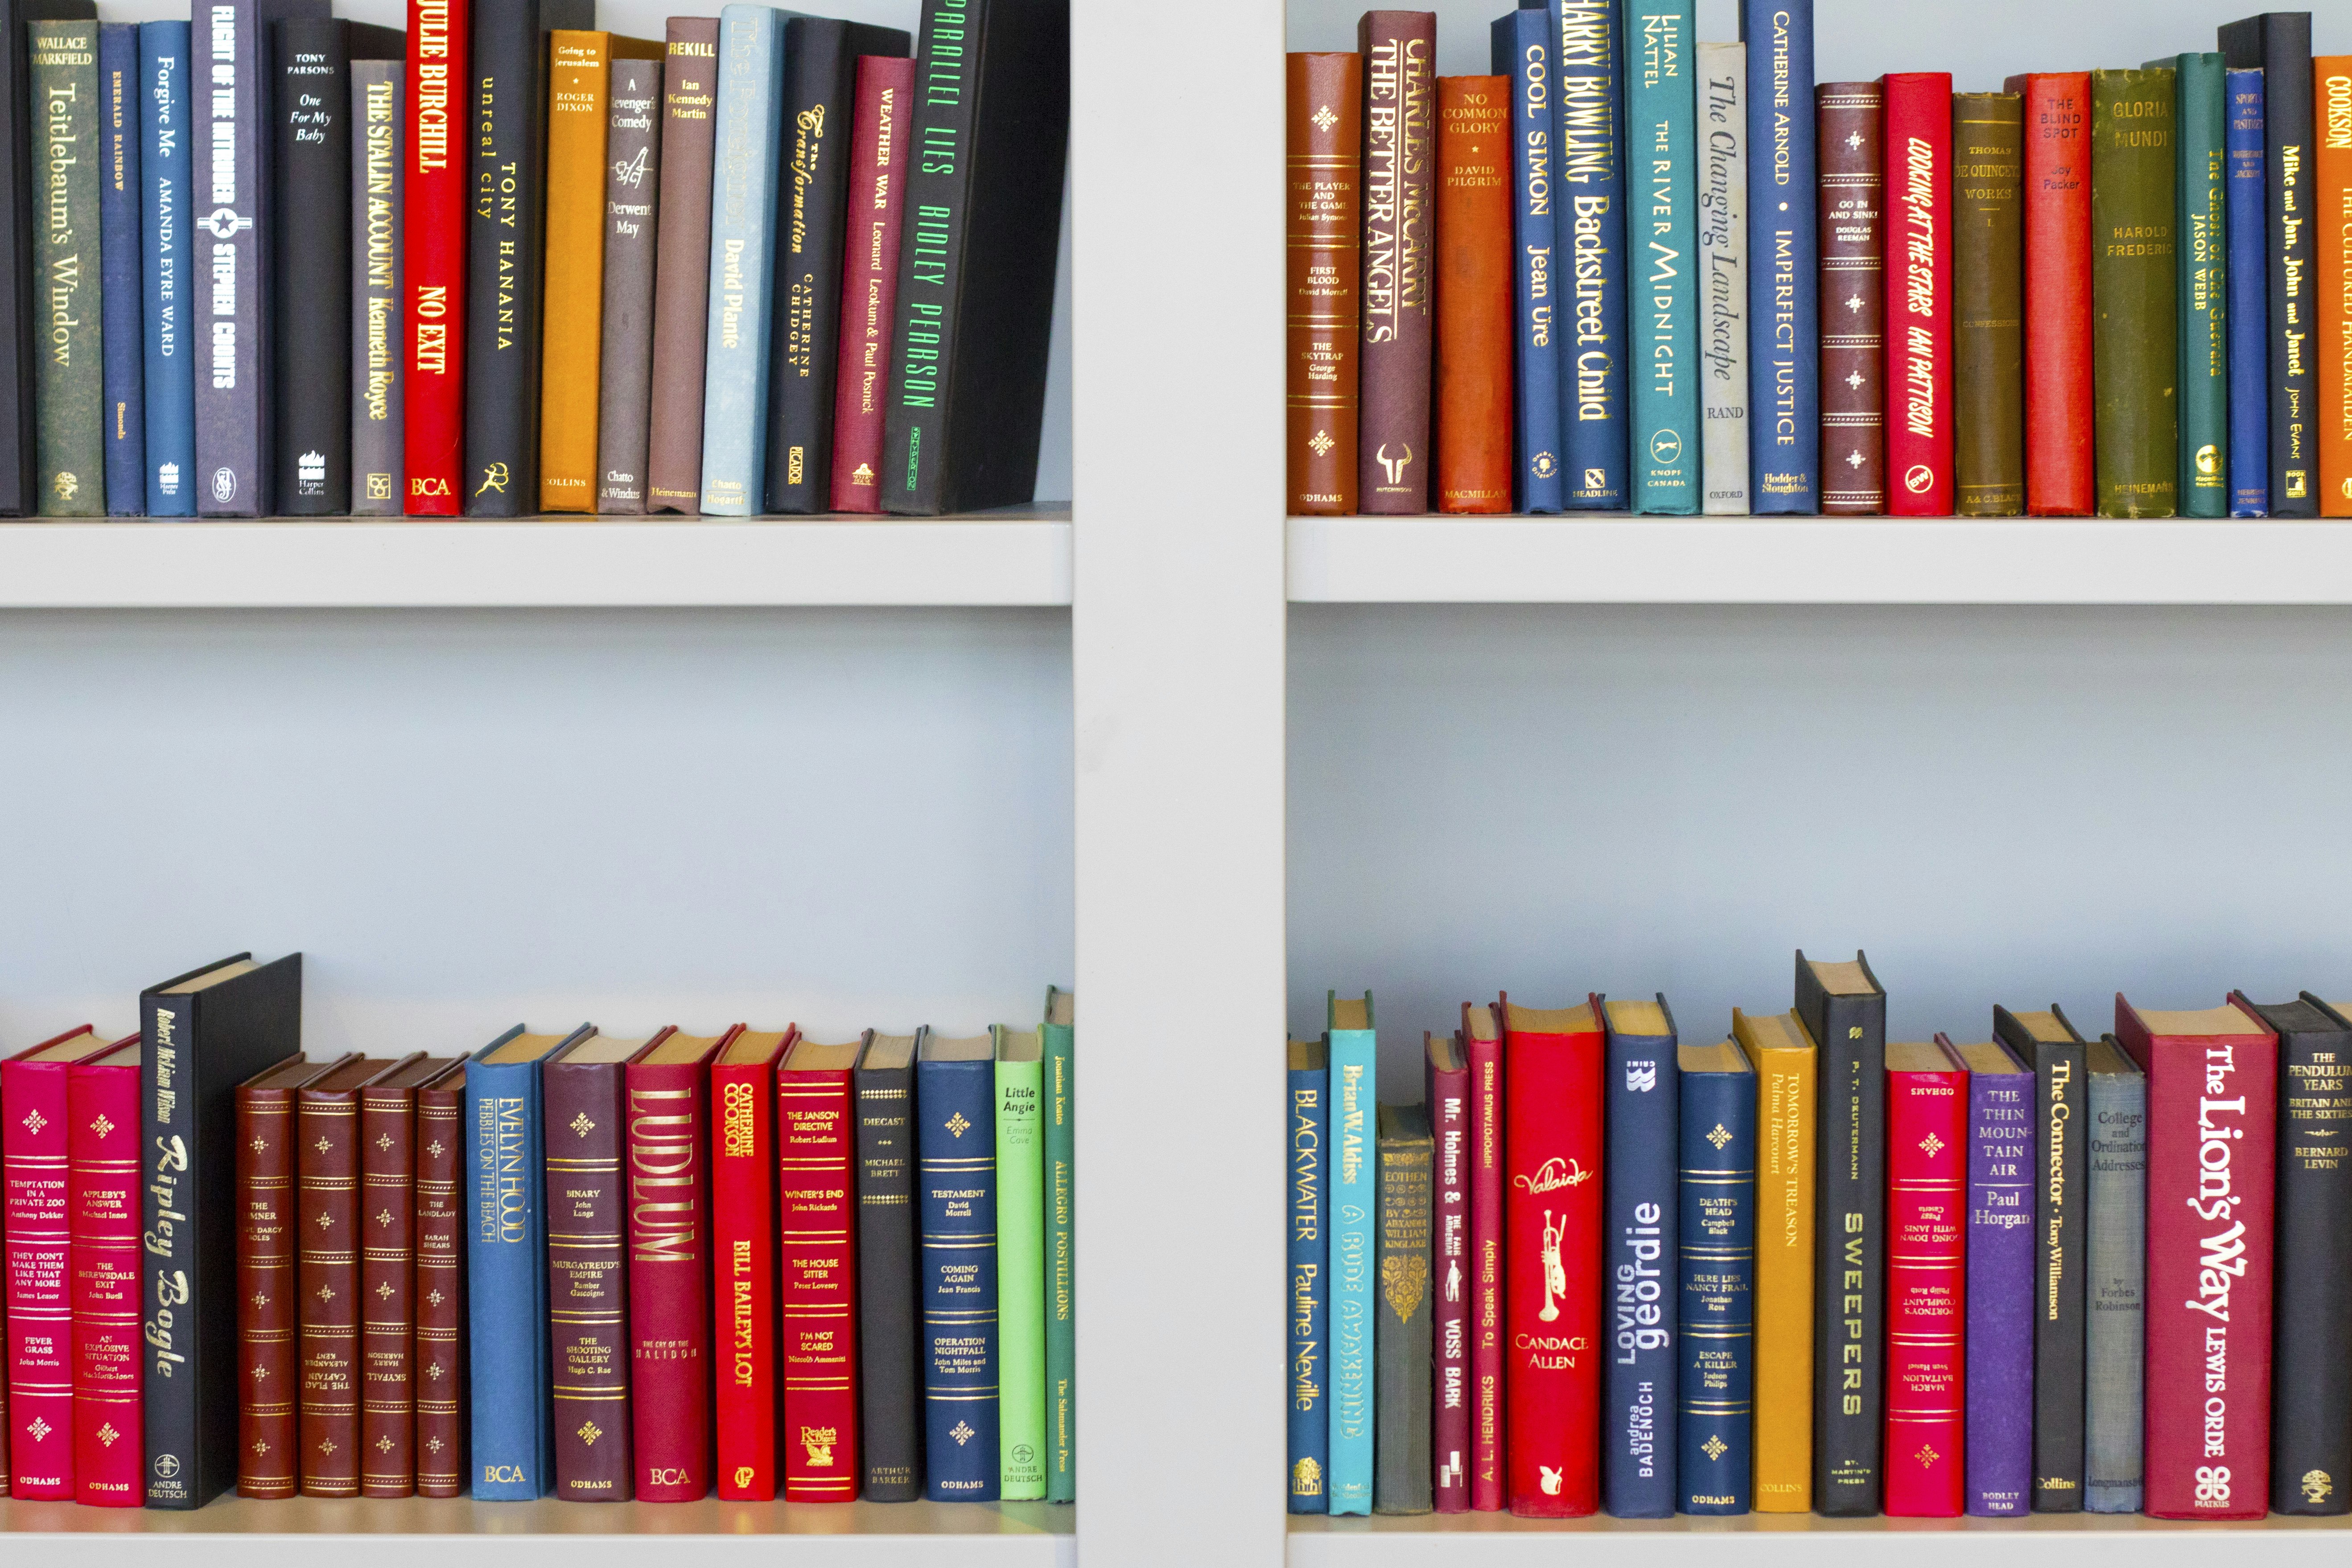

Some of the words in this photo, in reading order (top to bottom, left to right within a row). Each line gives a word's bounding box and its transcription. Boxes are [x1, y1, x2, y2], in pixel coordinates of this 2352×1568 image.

[212, 6, 235, 62] FLIGHT
[1642, 16, 1662, 88] NATTEL
[1661, 15, 1681, 76] LILIAN
[212, 65, 235, 85] OF
[288, 66, 334, 75] PARSONS
[295, 54, 325, 63] TONY
[1774, 11, 1790, 107] CATHERINE
[113, 71, 122, 128] EMERALD
[153, 57, 174, 124] Forgive
[300, 94, 321, 106] One
[367, 81, 393, 123] THE
[556, 93, 594, 102] ROGER
[628, 78, 636, 91] A
[1464, 94, 1487, 104] NO
[1527, 45, 1546, 119] COOL
[1709, 76, 1736, 123] The
[213, 88, 235, 118] THE
[290, 111, 309, 123] For
[313, 112, 332, 126] My
[482, 77, 496, 156] unreal
[556, 103, 593, 112] DIXON
[1443, 108, 1507, 119] COMMON
[2041, 113, 2081, 124] BLIND
[2048, 99, 2073, 110] THE
[2326, 76, 2352, 148] COOKSON
[159, 130, 175, 157] Me
[296, 129, 325, 144] Baby
[877, 88, 893, 166] WEATHER
[1450, 123, 1501, 133] GLORY
[1656, 120, 1668, 152] THE
[114, 134, 124, 191] RAINBOW
[213, 122, 235, 204] INTRUDER
[367, 126, 393, 195] STALIN
[922, 128, 956, 174] LIES
[1775, 112, 1790, 185] ARNOLD
[1447, 177, 1501, 186] PILGRIM
[1455, 166, 1494, 175] DAVID
[1528, 131, 1549, 215] SIMON
[1701, 131, 1738, 247] Changing
[1902, 137, 1933, 208] LOOKING
[478, 173, 494, 218] city
[500, 162, 516, 228] TONY
[875, 174, 889, 210] WAR
[1653, 160, 1671, 235] RIVER
[1839, 201, 1854, 209] GO
[160, 177, 173, 253] AMANDA
[616, 221, 639, 238] May
[1907, 206, 1933, 235] AT
[368, 198, 394, 289] ACCOUNT
[914, 205, 950, 285] RIDLEY
[1908, 232, 1933, 267] THE
[2191, 213, 2206, 262] JASON
[161, 258, 173, 300] EYRE
[213, 243, 235, 315] STEPHEN
[498, 241, 514, 350] HANANIA
[1307, 276, 1339, 284] BLOOD
[1776, 230, 1794, 352] IMPERFECT
[1908, 264, 1933, 317] STARS
[2194, 268, 2207, 310] WEBB
[418, 286, 446, 317] NO
[1649, 241, 1679, 396] MIDNIGHT
[1705, 252, 1739, 380] Landscape
[161, 305, 173, 357] WARD
[417, 324, 445, 375] EXIT
[1312, 343, 1331, 351] THE
[1908, 326, 1933, 358] IAN
[213, 322, 235, 388] COONTS
[903, 304, 942, 407] PEARSON
[1707, 407, 1743, 419] RAND
[1773, 360, 1795, 445] JUSTICE
[1908, 357, 1933, 438] PATTISON
[411, 478, 451, 495] BCA
[1709, 491, 1742, 499] OXFORD
[1485, 1061, 1493, 1091] PRESS
[2206, 1045, 2236, 1095] The
[2312, 1053, 2336, 1062] THE
[1005, 1087, 1035, 1098] Little
[1987, 1091, 2019, 1102] THE
[2052, 1060, 2070, 1101] The
[2303, 1079, 2343, 1091] YEARS
[794, 1123, 833, 1131] DIRECTIVE
[804, 1111, 839, 1119] JANSON
[1004, 1101, 1035, 1115] Angie
[1445, 1098, 1461, 1122] Mr.
[1983, 1109, 2024, 1120] THIN
[499, 1097, 524, 1172] EVELYN
[1484, 1094, 1493, 1169] HIPPOPOTAMUS
[1984, 1146, 2023, 1157] TAIN
[2294, 1147, 2348, 1156] BERNARD
[631, 1087, 695, 1261] LUDLUM
[1295, 1089, 1318, 1242] BLACKWATER
[1445, 1131, 1461, 1185] Holmes
[1990, 1165, 2018, 1175] AIR
[2051, 1103, 2070, 1206] Connector
[2187, 1096, 2245, 1220] Lion's
[2305, 1160, 2338, 1169] LEVIN
[144, 1135, 187, 1257] Ripley
[501, 1178, 525, 1243] HOOD
[566, 1189, 601, 1198] BINARY
[785, 1190, 824, 1198] WINTER'S
[1445, 1191, 1461, 1204] &
[1705, 1208, 1732, 1216] HEAD
[1987, 1192, 2019, 1206] Paul
[1975, 1210, 2030, 1228] Horgan
[2047, 1216, 2062, 1247] Tony
[12, 1261, 36, 1269] MAKE
[15, 1279, 33, 1287] ANY
[35, 1280, 61, 1288] MORE
[95, 1281, 115, 1289] EXIT
[941, 1265, 978, 1273] COMING
[1626, 1202, 1670, 1350] geordie
[2049, 1247, 2063, 1320] Williamson
[2185, 1220, 2248, 1322] Way
[1295, 1264, 1318, 1337] Pauline
[1843, 1213, 1863, 1416] SWEEPERS
[25, 1337, 52, 1346] FEVER
[145, 1269, 189, 1378] Bogle
[1446, 1319, 1461, 1359] VOSS
[25, 1346, 53, 1354] GRASS
[2205, 1327, 2226, 1393] LEWIS
[1296, 1341, 1319, 1412] Neville
[1445, 1367, 1461, 1409] BARK
[1630, 1405, 1639, 1455] andrea
[1639, 1382, 1652, 1477] BADENOCH
[2204, 1397, 2225, 1458] ORDE
[20, 1477, 61, 1486] ODHAMS
[89, 1482, 129, 1491] ODHAMS
[484, 1465, 526, 1482] BCA
[650, 1468, 690, 1485] BCA
[1692, 1496, 1735, 1504] ODHAMS
